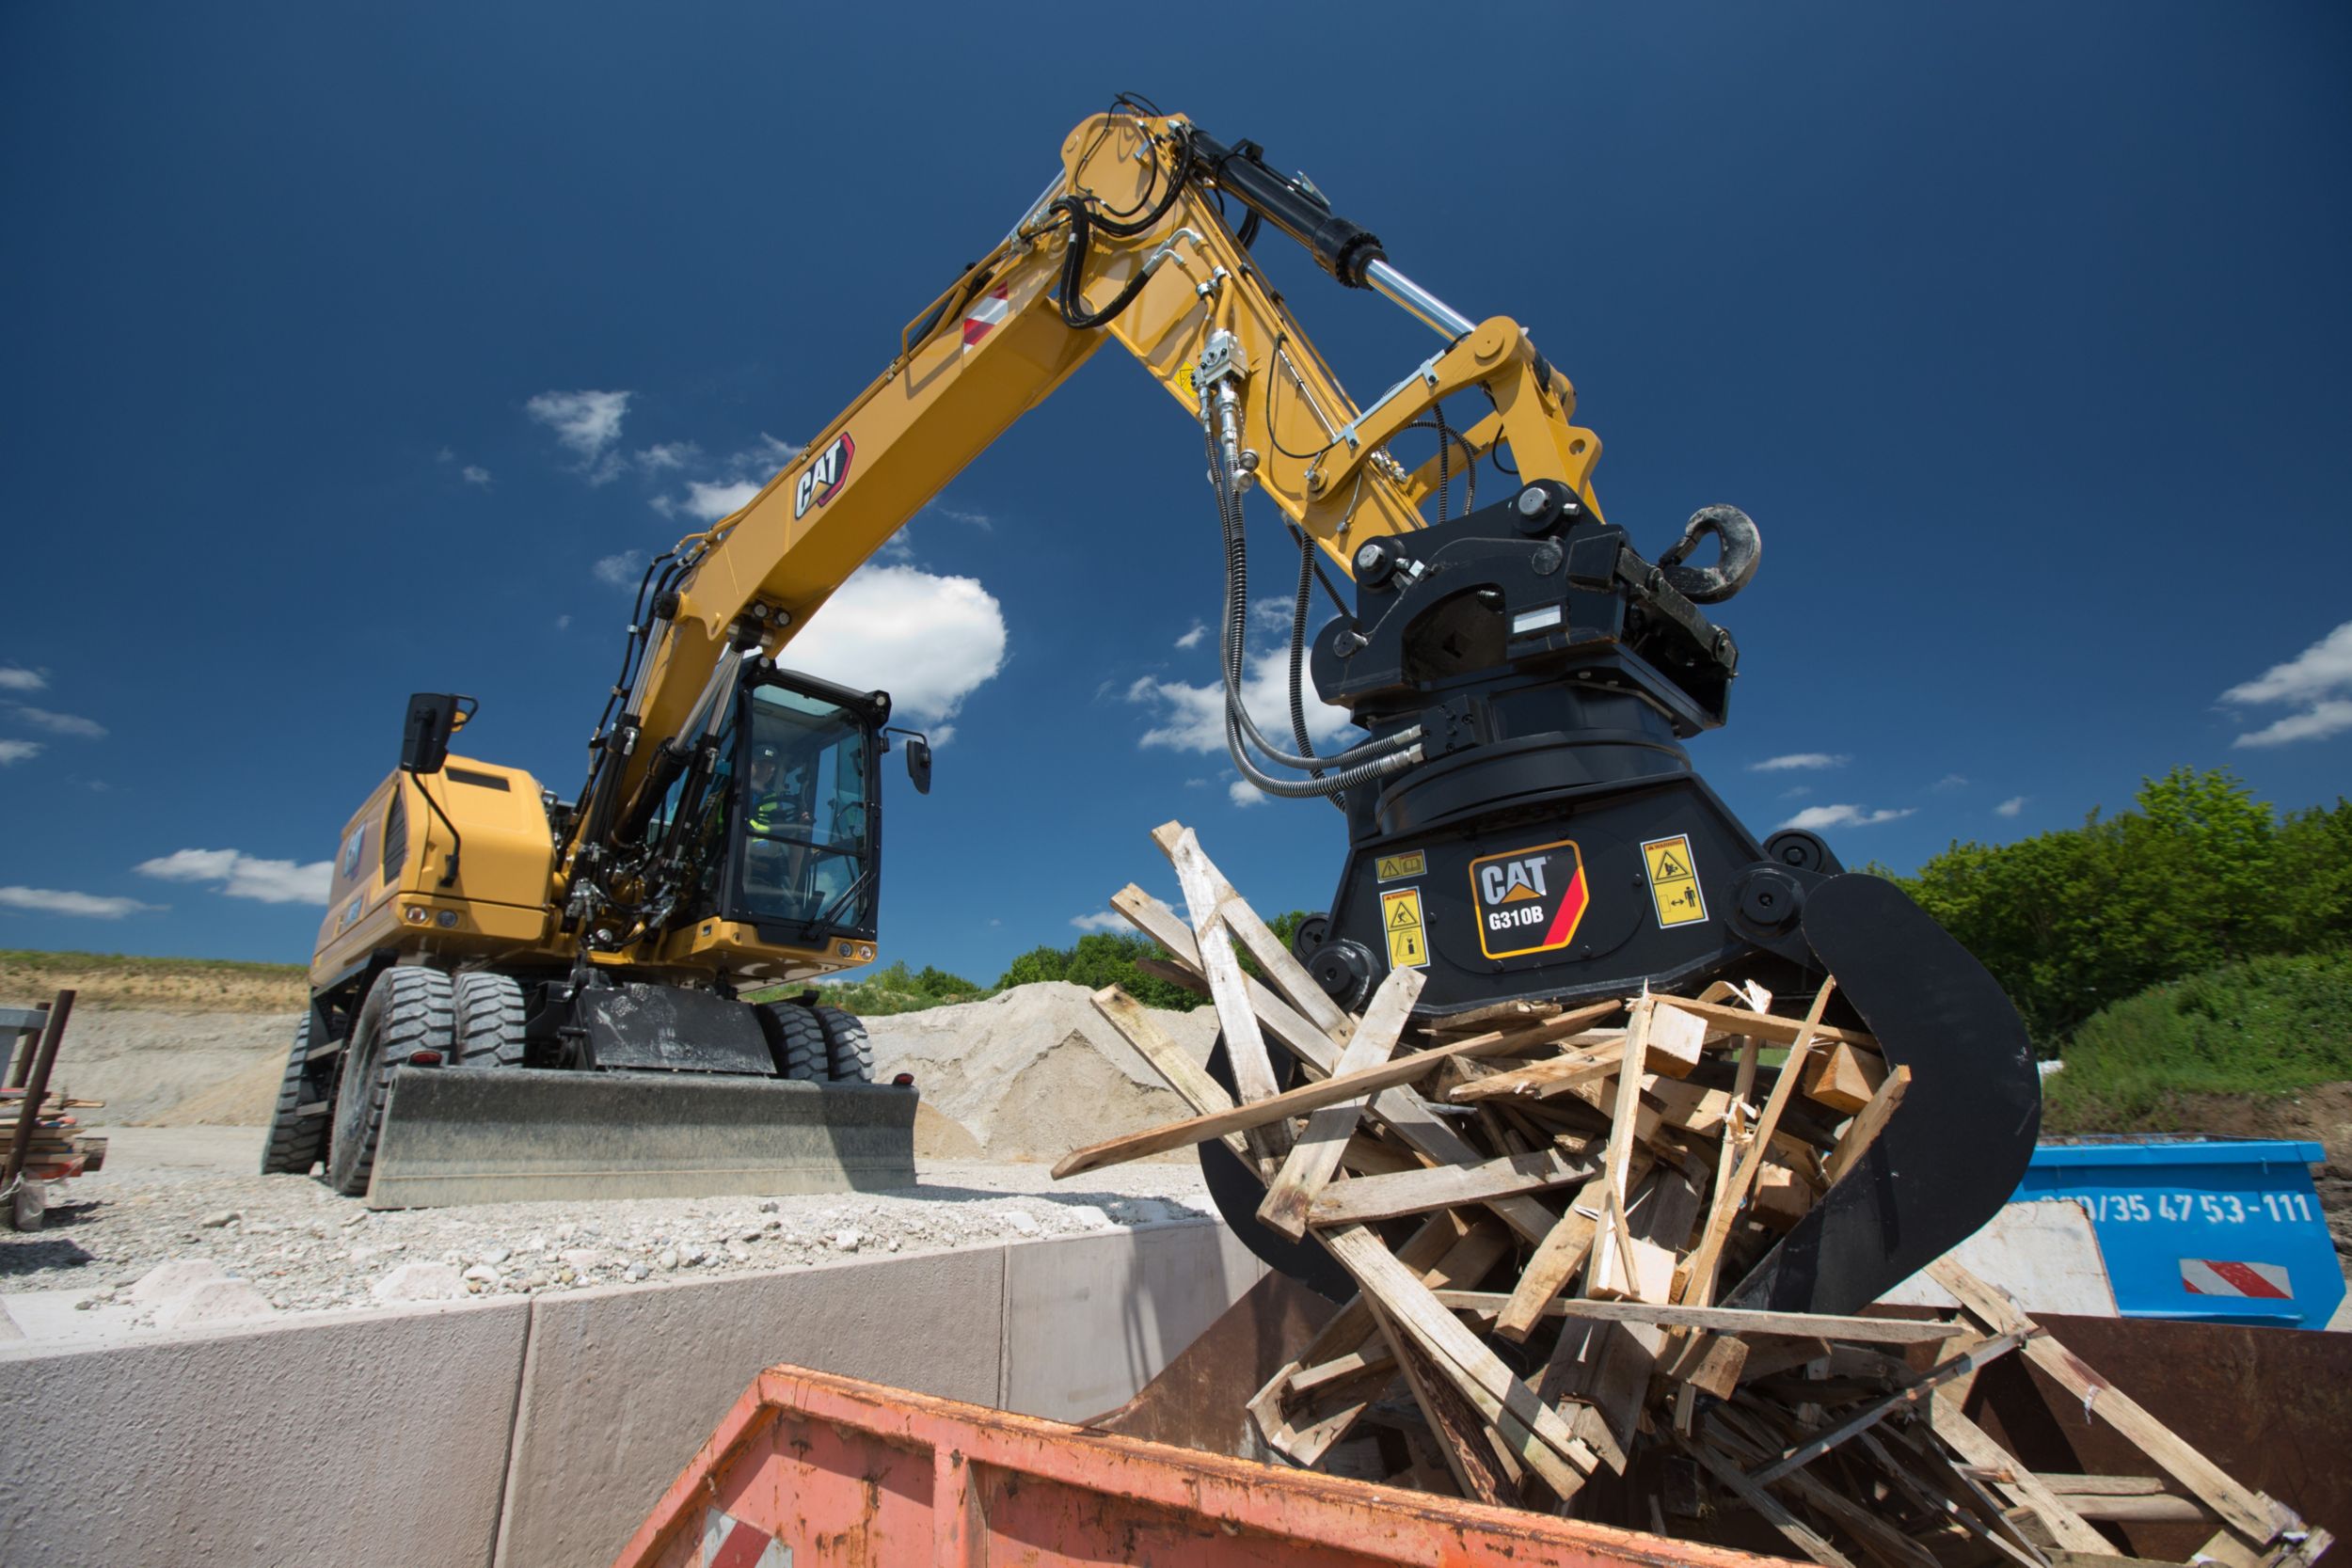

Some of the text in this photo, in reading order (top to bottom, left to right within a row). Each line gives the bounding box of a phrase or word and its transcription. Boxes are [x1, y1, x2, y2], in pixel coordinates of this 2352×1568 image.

[796, 438, 841, 518] CAT
[1482, 856, 1547, 905] CAT
[1488, 906, 1544, 930] G310B
[2159, 1194, 2193, 1222] 47
[2200, 1194, 2312, 1223] 53-111
